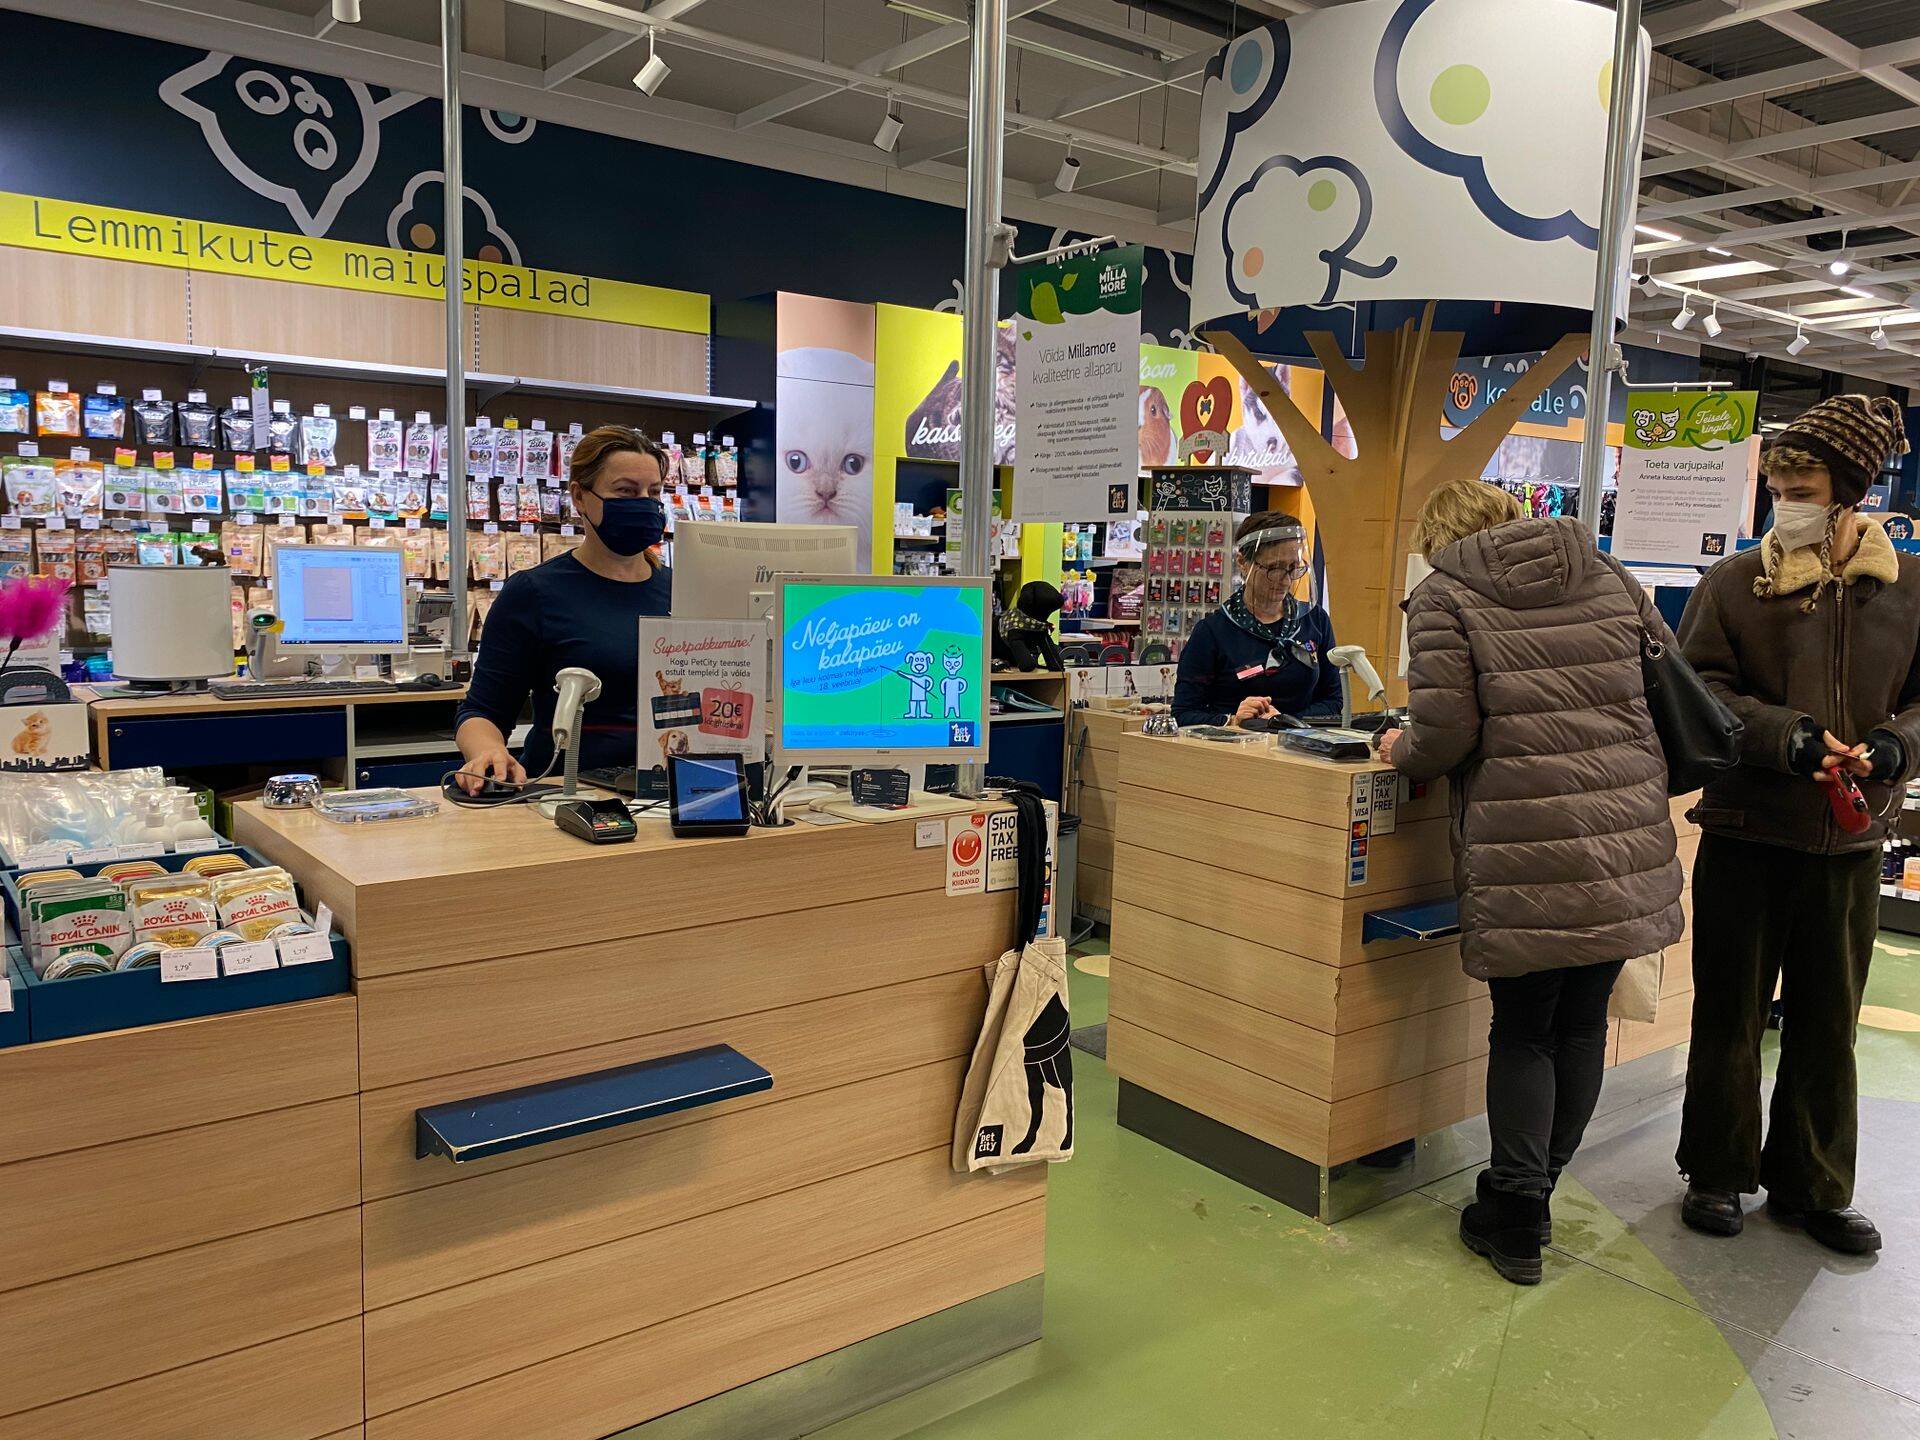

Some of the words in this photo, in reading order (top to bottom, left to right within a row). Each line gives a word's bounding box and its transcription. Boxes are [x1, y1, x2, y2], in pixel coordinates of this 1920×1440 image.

[33, 200, 314, 272] Lemmikute
[1099, 267, 1127, 284] MILLA
[1100, 279, 1126, 294] MORE
[1039, 346, 1065, 364] Võida
[1067, 341, 1116, 360] Millamore
[1032, 366, 1081, 384] kvaliteetne
[1084, 360, 1122, 379] allapanu
[1696, 410, 1731, 425] Teisele
[1644, 459, 1669, 470] Toeta
[1673, 459, 1724, 472] varjupaika!
[792, 616, 894, 651] Neljapäev
[898, 611, 921, 627] on
[653, 634, 755, 657] Superpakkumine!
[818, 639, 904, 671] kalapäev
[670, 658, 689, 668] Kogu
[691, 658, 717, 668] PetCity
[720, 659, 751, 667] teenuste
[721, 669, 729, 679] ja
[731, 669, 751, 678] võida
[710, 699, 744, 719] 20€
[953, 733, 971, 743] city
[955, 726, 969, 738] pet
[1375, 775, 1396, 787] SHOP
[1374, 787, 1390, 799] TAX
[1354, 807, 1369, 817] VISA
[1373, 800, 1394, 812] FREE
[991, 816, 1018, 831] SHO
[991, 831, 1014, 847] TAX
[991, 846, 1019, 862] FREE
[952, 868, 980, 878] KLIENDID
[951, 878, 980, 888] KIIDAVAD
[231, 905, 261, 922] ROYAL
[260, 899, 290, 915] CANIN
[143, 915, 177, 926] ROYAL
[50, 930, 84, 942] ROYAL
[86, 924, 120, 937] CANIN
[979, 1140, 998, 1152] city
[980, 1132, 995, 1145] pet
